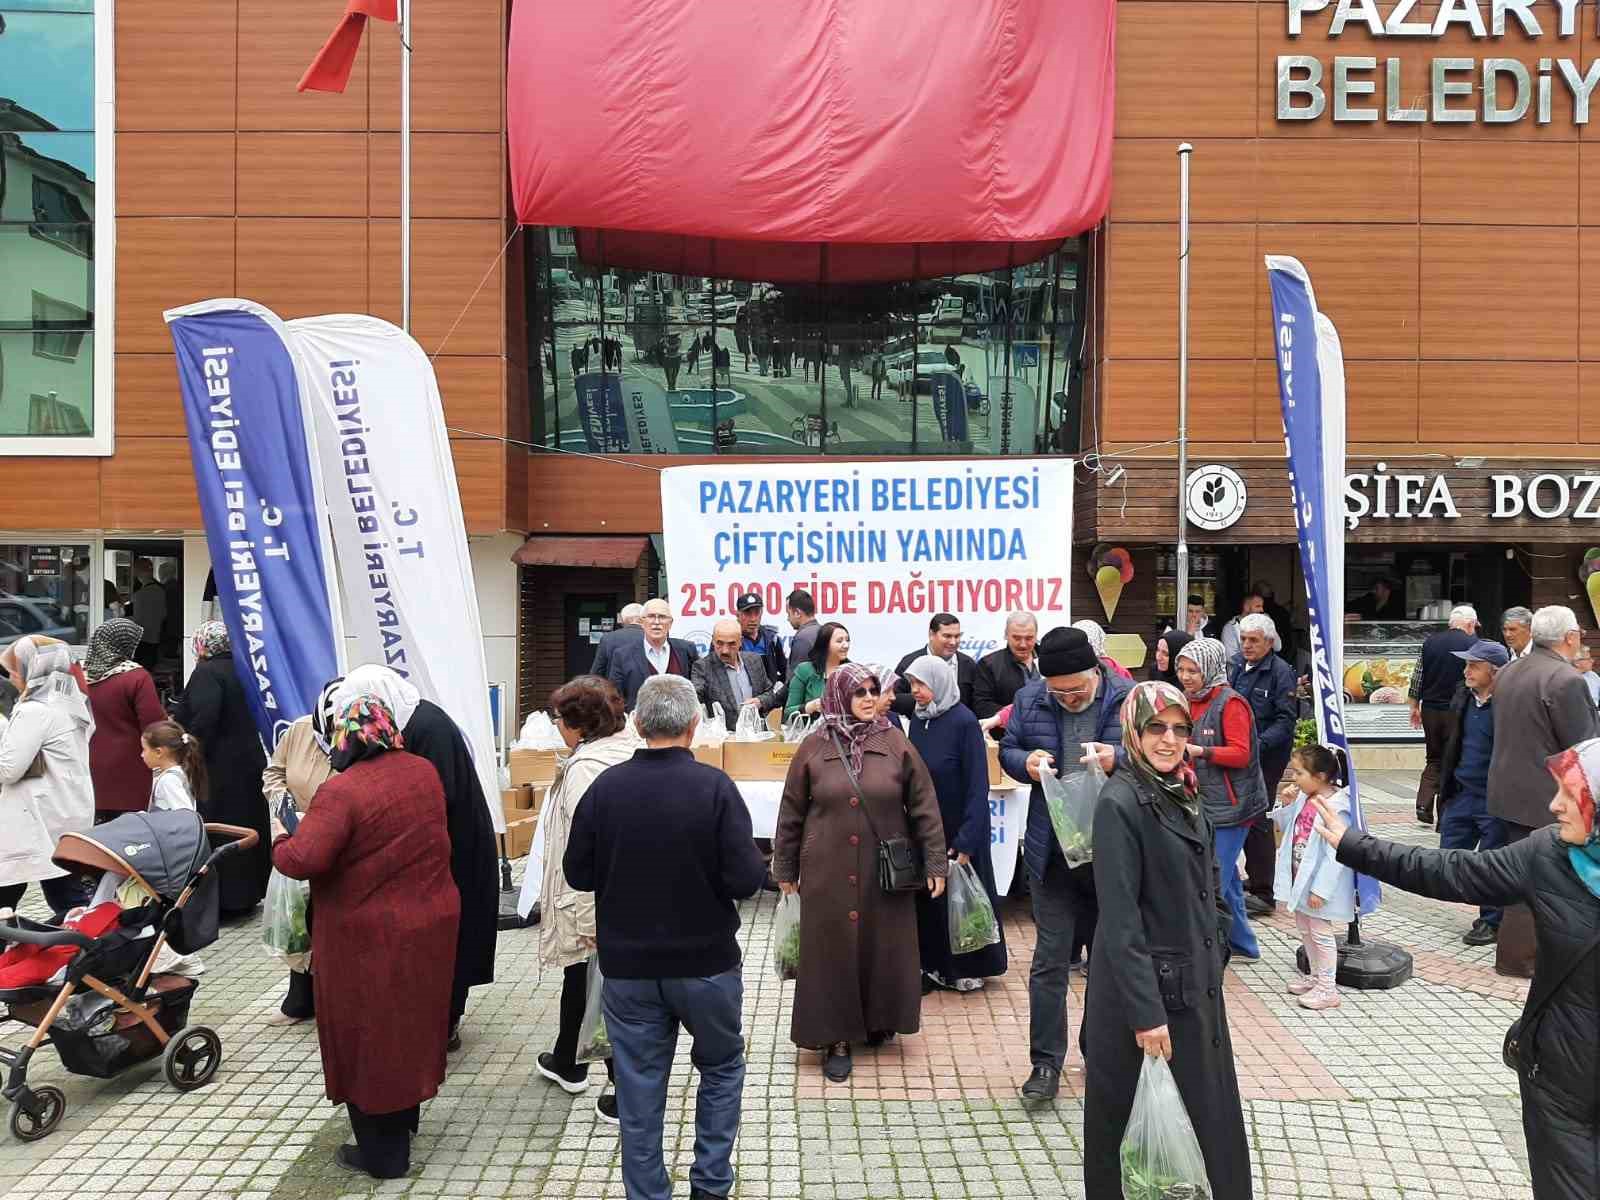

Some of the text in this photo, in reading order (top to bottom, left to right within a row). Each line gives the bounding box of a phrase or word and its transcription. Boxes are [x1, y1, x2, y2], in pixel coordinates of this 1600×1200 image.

[1287, 0, 1600, 37] PAZARY
[699, 466, 1040, 514] PAZARYERİ BELEDİYESİ
[1343, 462, 1461, 531] ŞİFA
[713, 521, 1028, 573] ÇİFTÇİSİNİN YANINDA
[867, 570, 1064, 614] DAĞITIYORUZ
